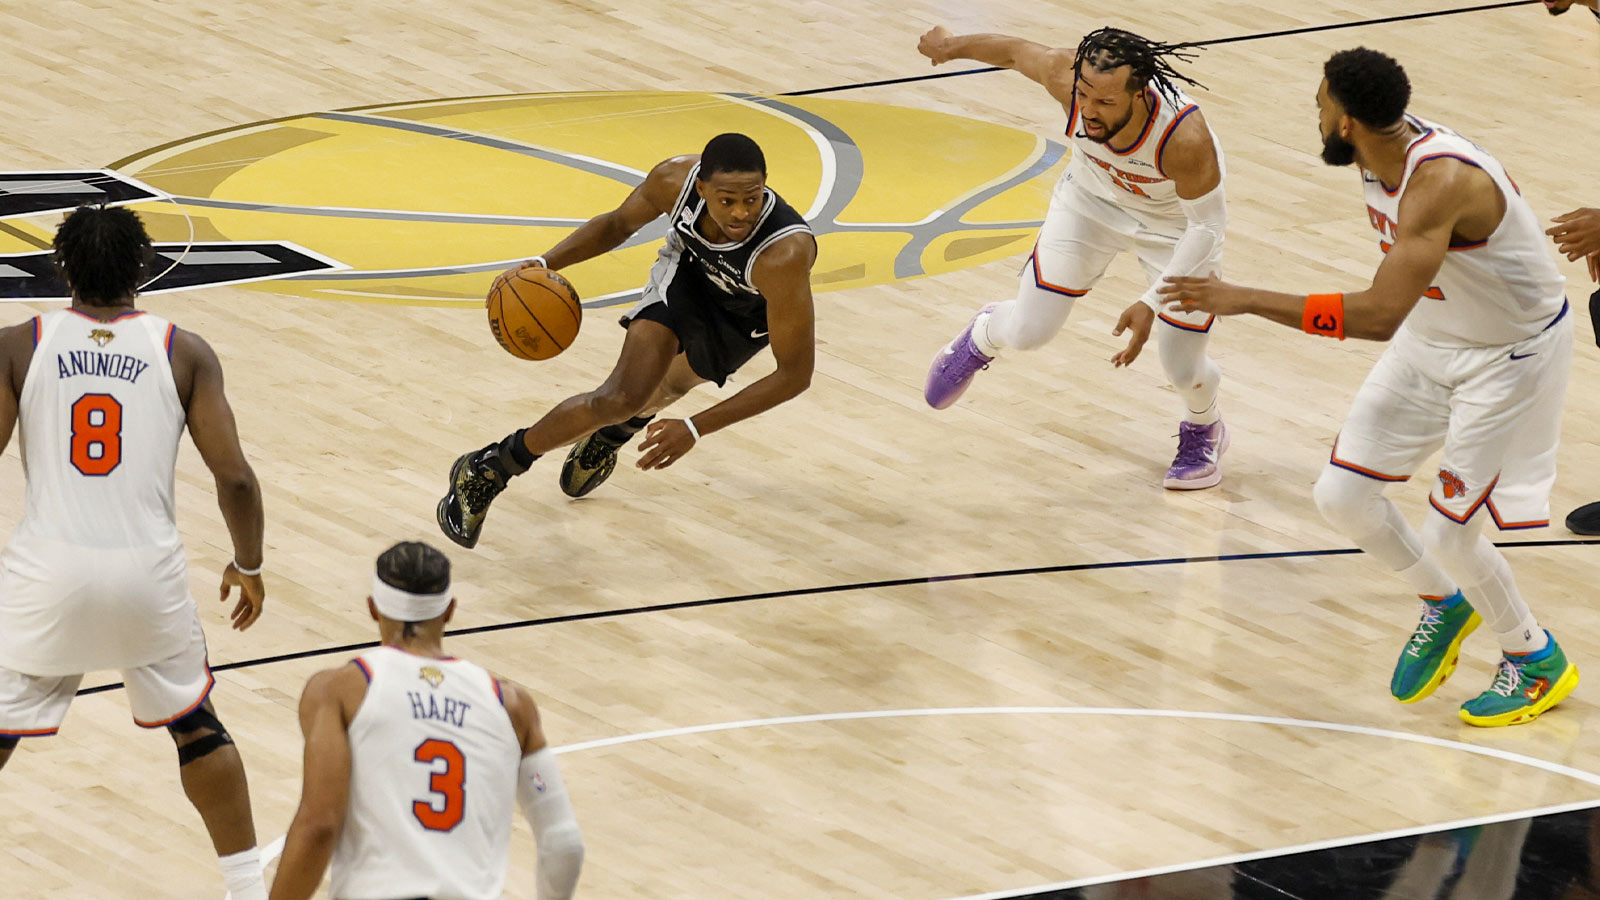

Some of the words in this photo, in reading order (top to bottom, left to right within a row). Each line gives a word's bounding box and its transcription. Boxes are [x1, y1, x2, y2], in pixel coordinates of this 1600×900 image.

[1313, 314, 1337, 331] 3
[57, 350, 149, 384] ANUNOBY
[69, 392, 122, 477] 8
[406, 690, 471, 728] HART
[411, 737, 467, 833] 3
